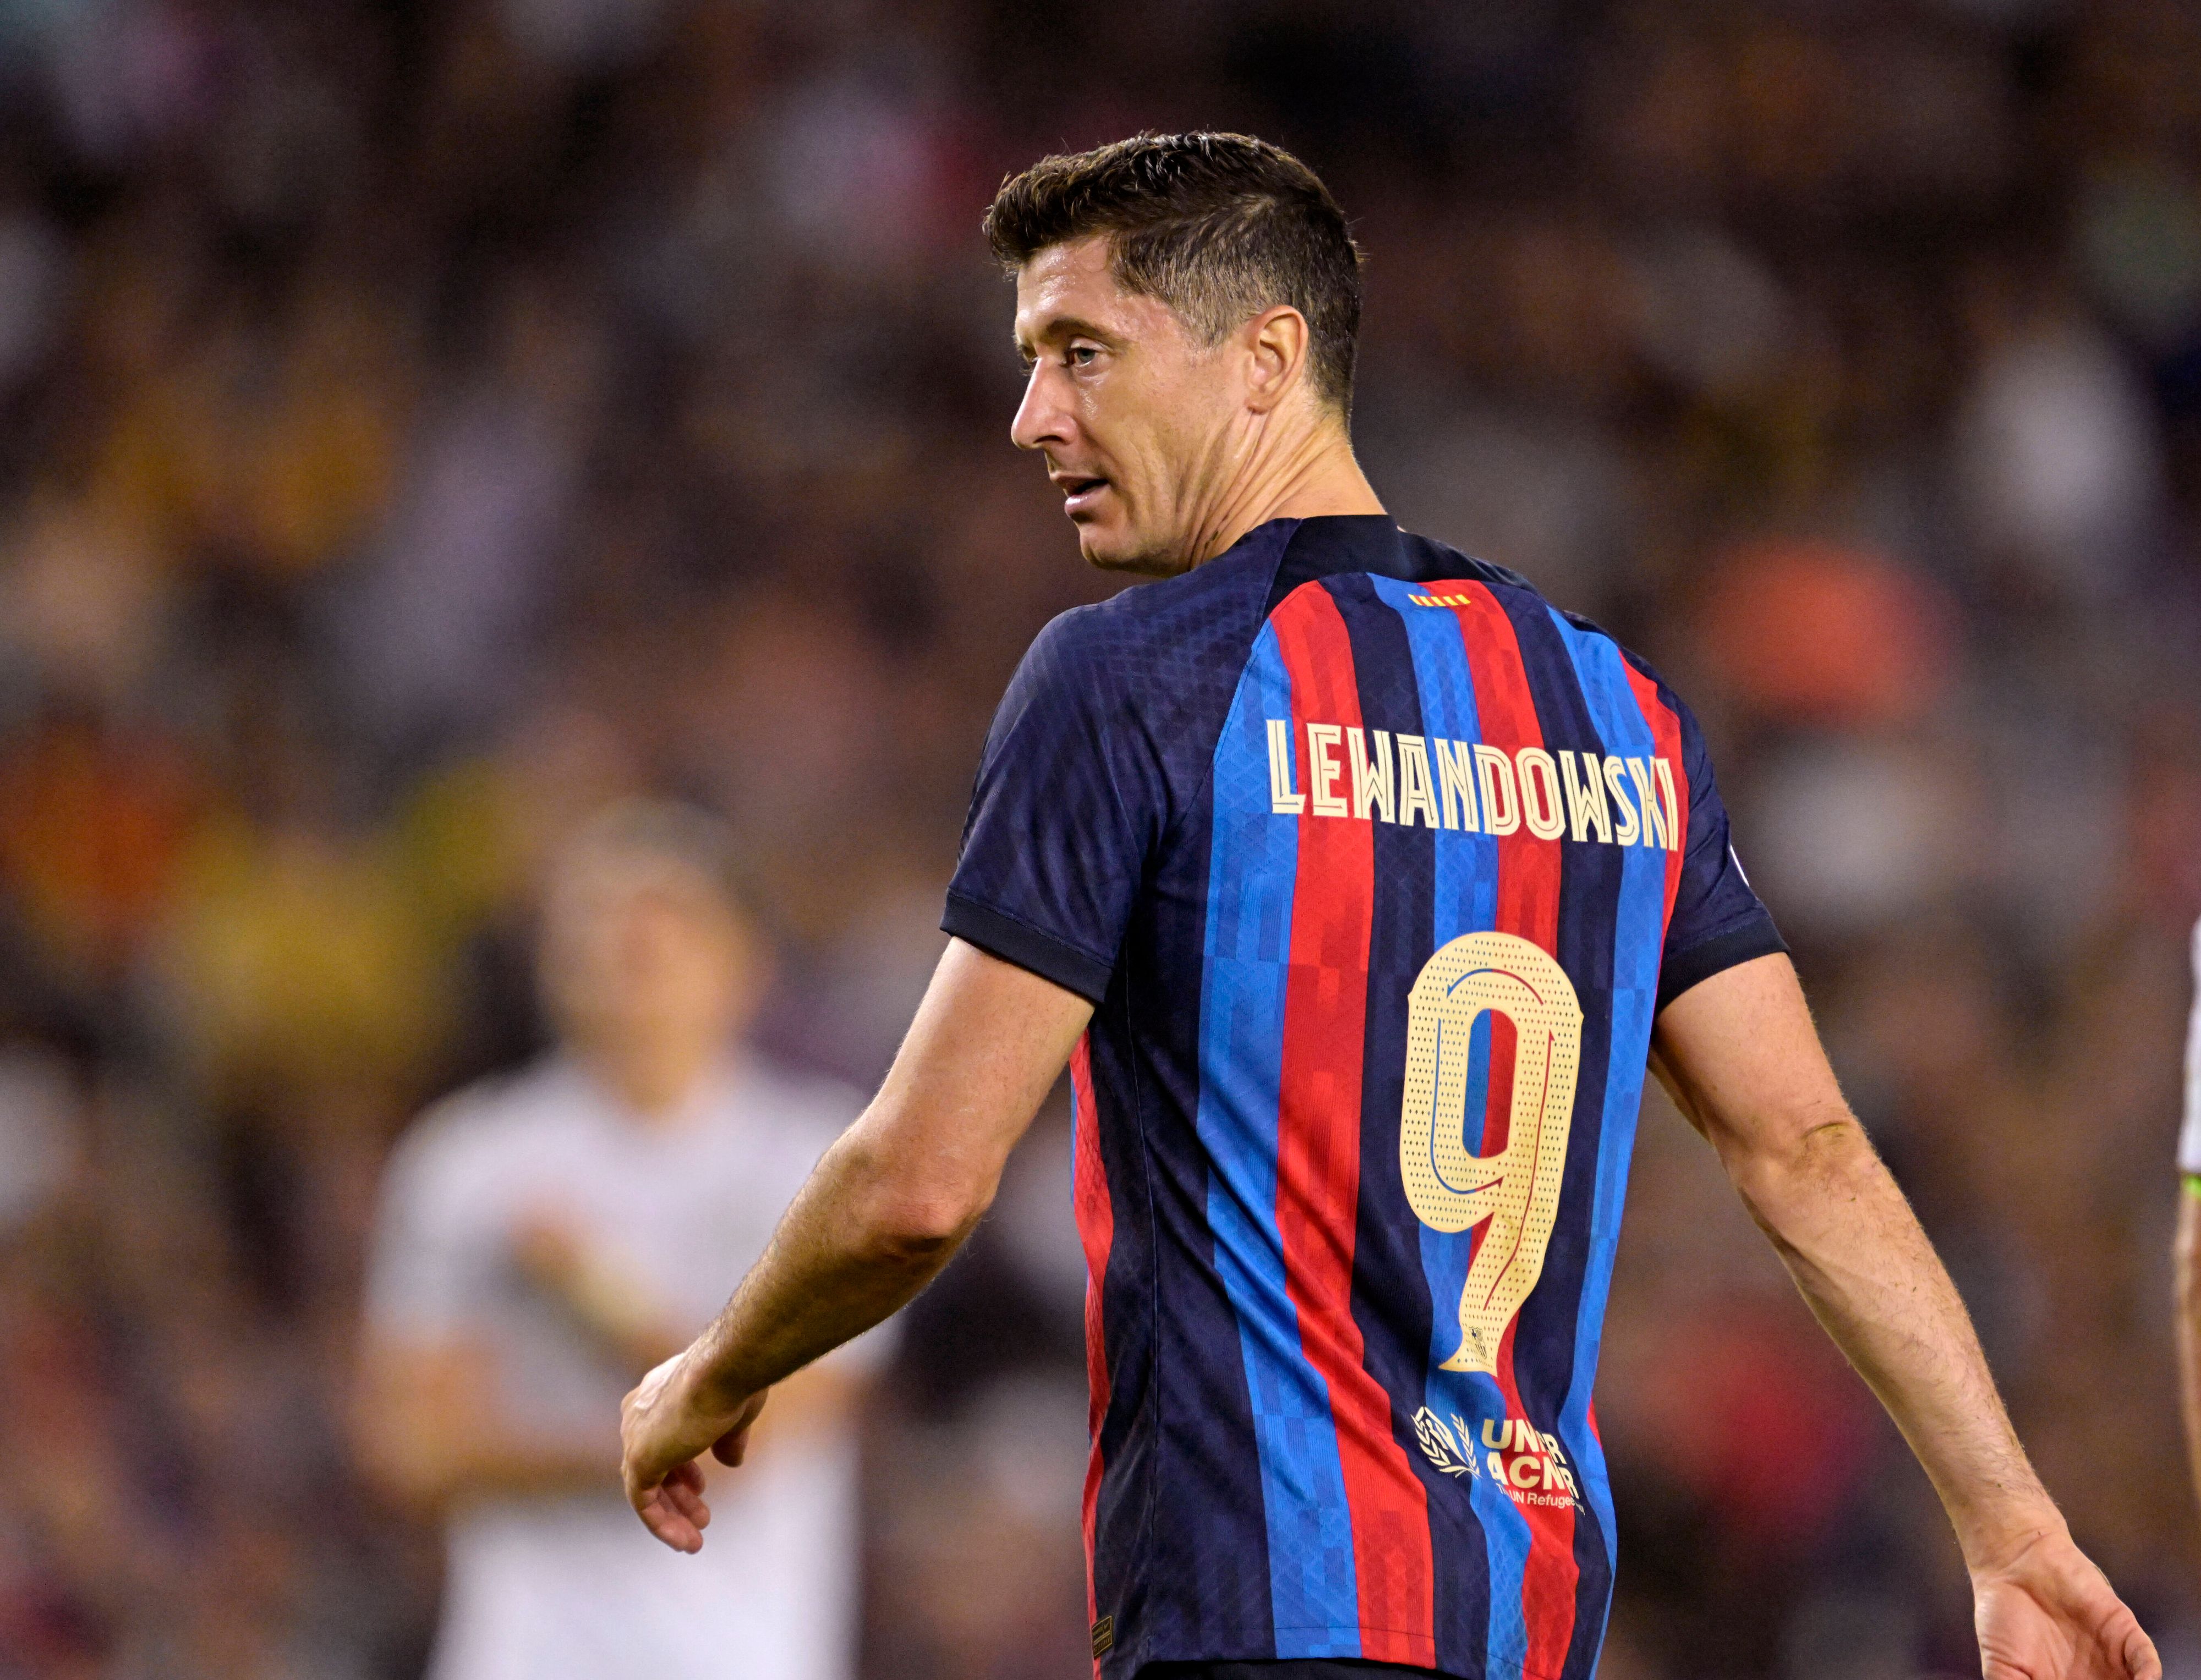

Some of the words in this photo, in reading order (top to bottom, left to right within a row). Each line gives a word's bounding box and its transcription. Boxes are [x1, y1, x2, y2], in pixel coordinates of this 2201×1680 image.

[1266, 719, 1678, 851] LEWANDOWSKI
[1399, 931, 1584, 1377] 9
[1509, 1490, 1524, 1504] UN
[1527, 1492, 1575, 1509] Refugee
